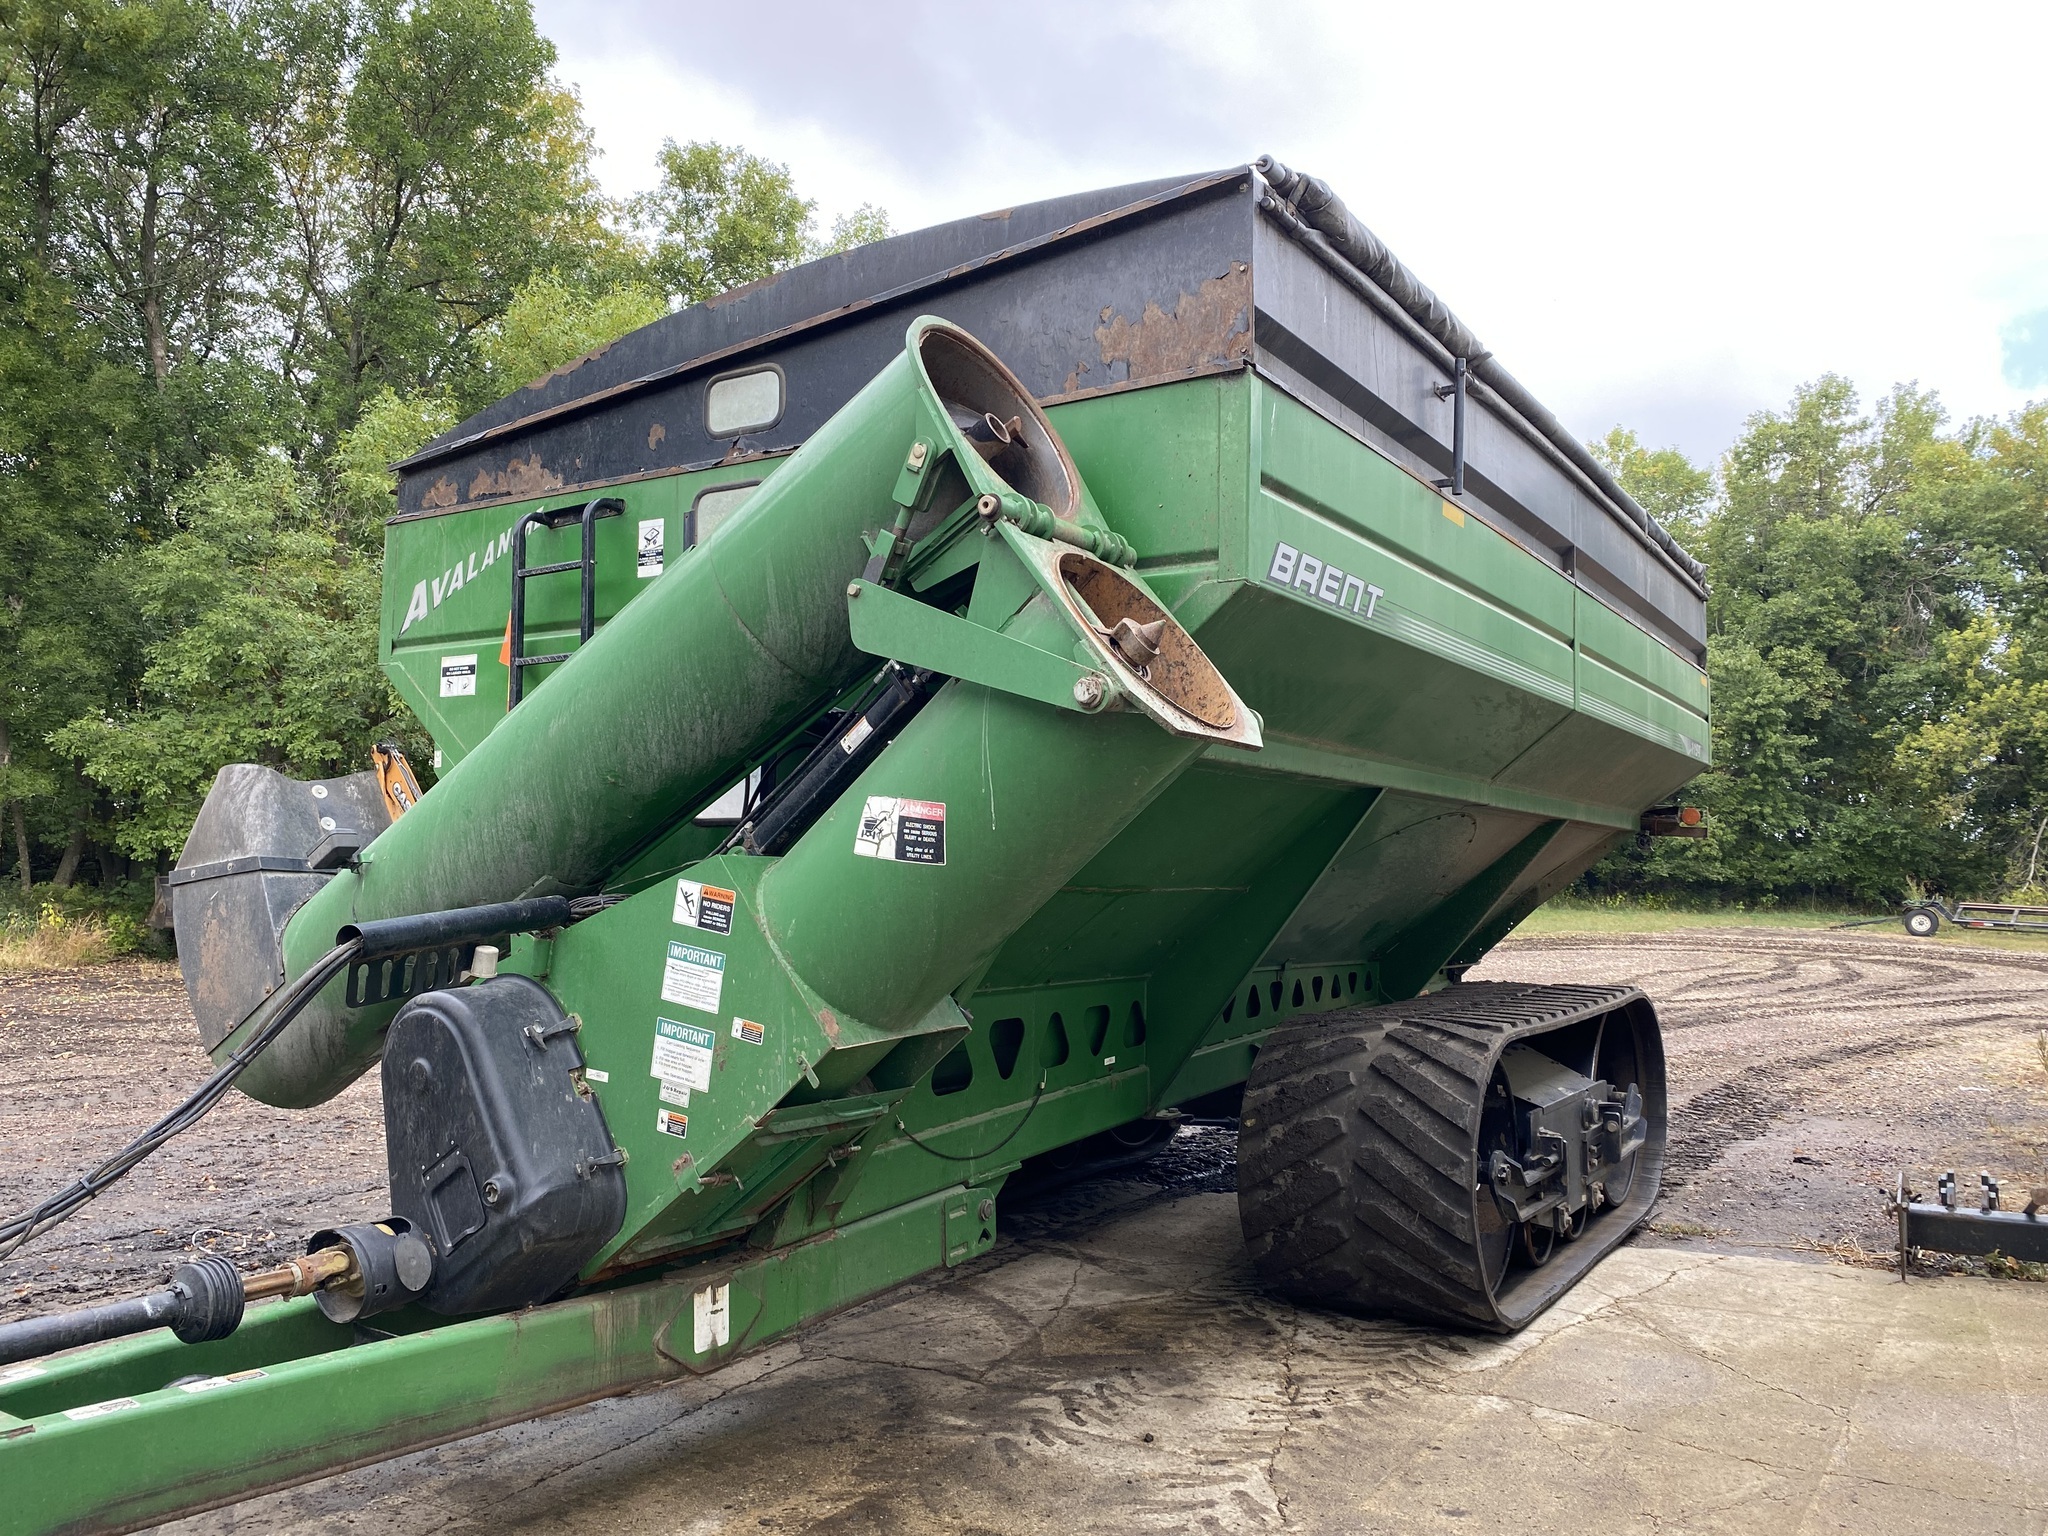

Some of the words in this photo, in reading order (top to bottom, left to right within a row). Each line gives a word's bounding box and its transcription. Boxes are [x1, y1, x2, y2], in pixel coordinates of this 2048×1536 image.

[398, 506, 544, 638] AVALANHE
[1267, 541, 1385, 620] BRENT
[392, 781, 412, 812] CAS
[910, 805, 943, 817] DANGER
[703, 900, 711, 908] NO
[711, 902, 731, 913] RIDERS
[709, 890, 734, 901] WARNING
[670, 945, 723, 969] IMPORTANT
[661, 1022, 710, 1047] IMPORTANT
[674, 1088, 688, 1097] Repair
